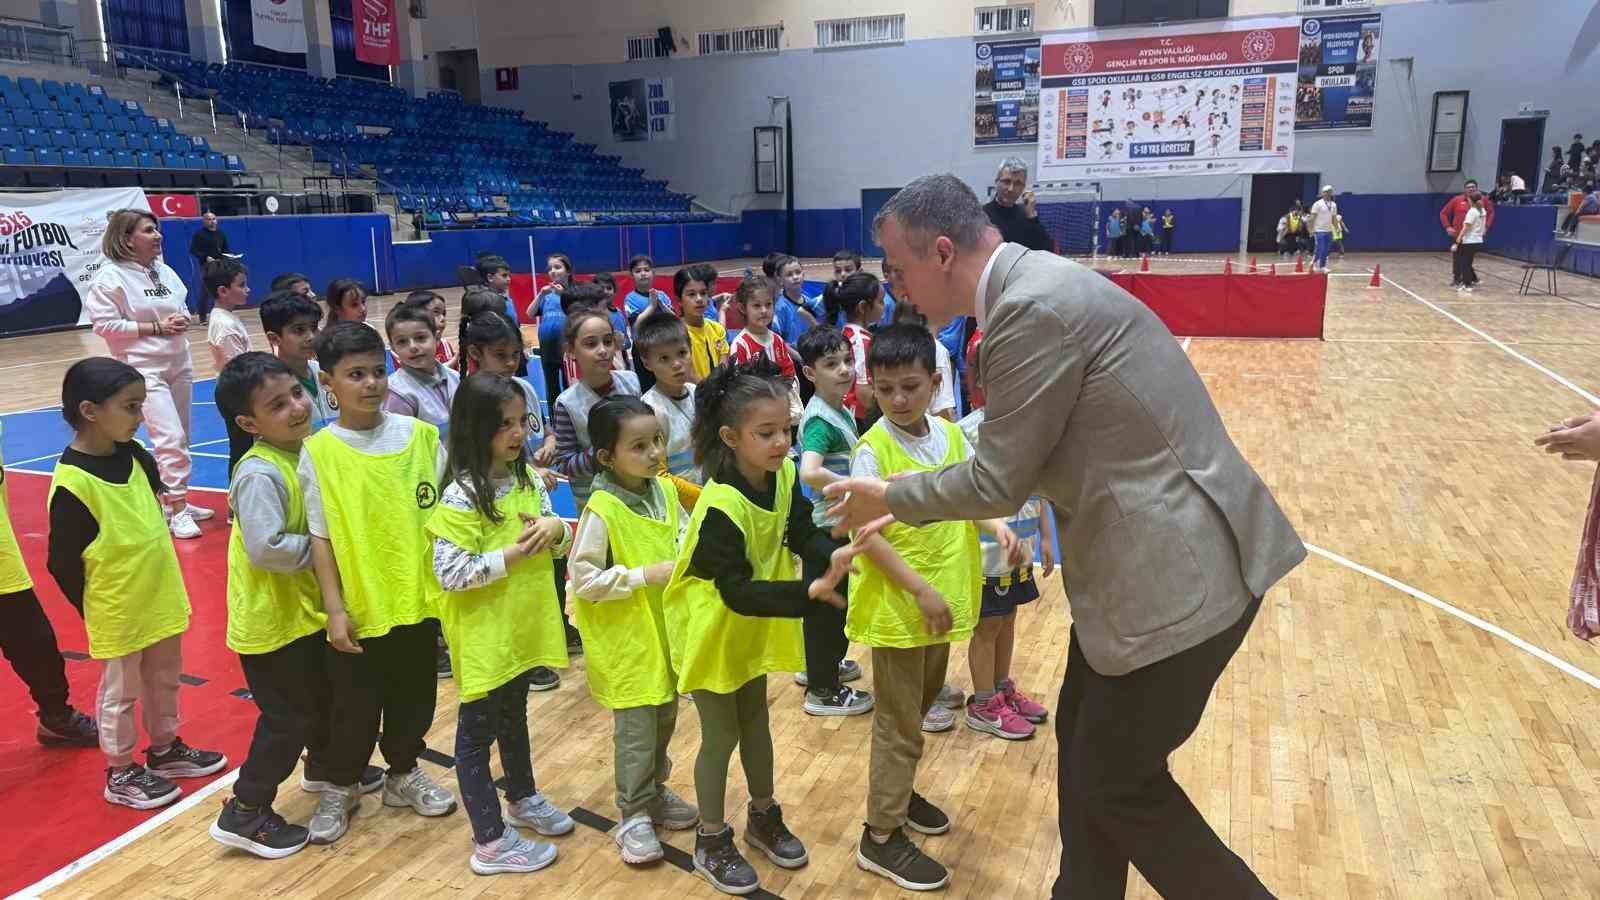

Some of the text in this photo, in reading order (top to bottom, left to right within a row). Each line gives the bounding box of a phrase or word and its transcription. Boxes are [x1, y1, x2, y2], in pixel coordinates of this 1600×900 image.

[363, 19, 391, 37] THF
[1105, 59, 1137, 69] GENÇLİK
[1138, 58, 1149, 66] VE
[1150, 56, 1169, 65] SPOR
[1178, 51, 1228, 63] MÜDÜRLÜĞÜ
[1139, 47, 1162, 56] AYDIN
[1072, 77, 1087, 86] GSB
[1087, 76, 1107, 85] SPOR
[1107, 74, 1143, 84] OKULLARI
[1151, 72, 1166, 81] GSB
[1203, 68, 1224, 77] SPOR
[1224, 66, 1263, 76] OKULLARI
[1328, 65, 1345, 74] SPOR
[13, 222, 79, 254] FUTBOL
